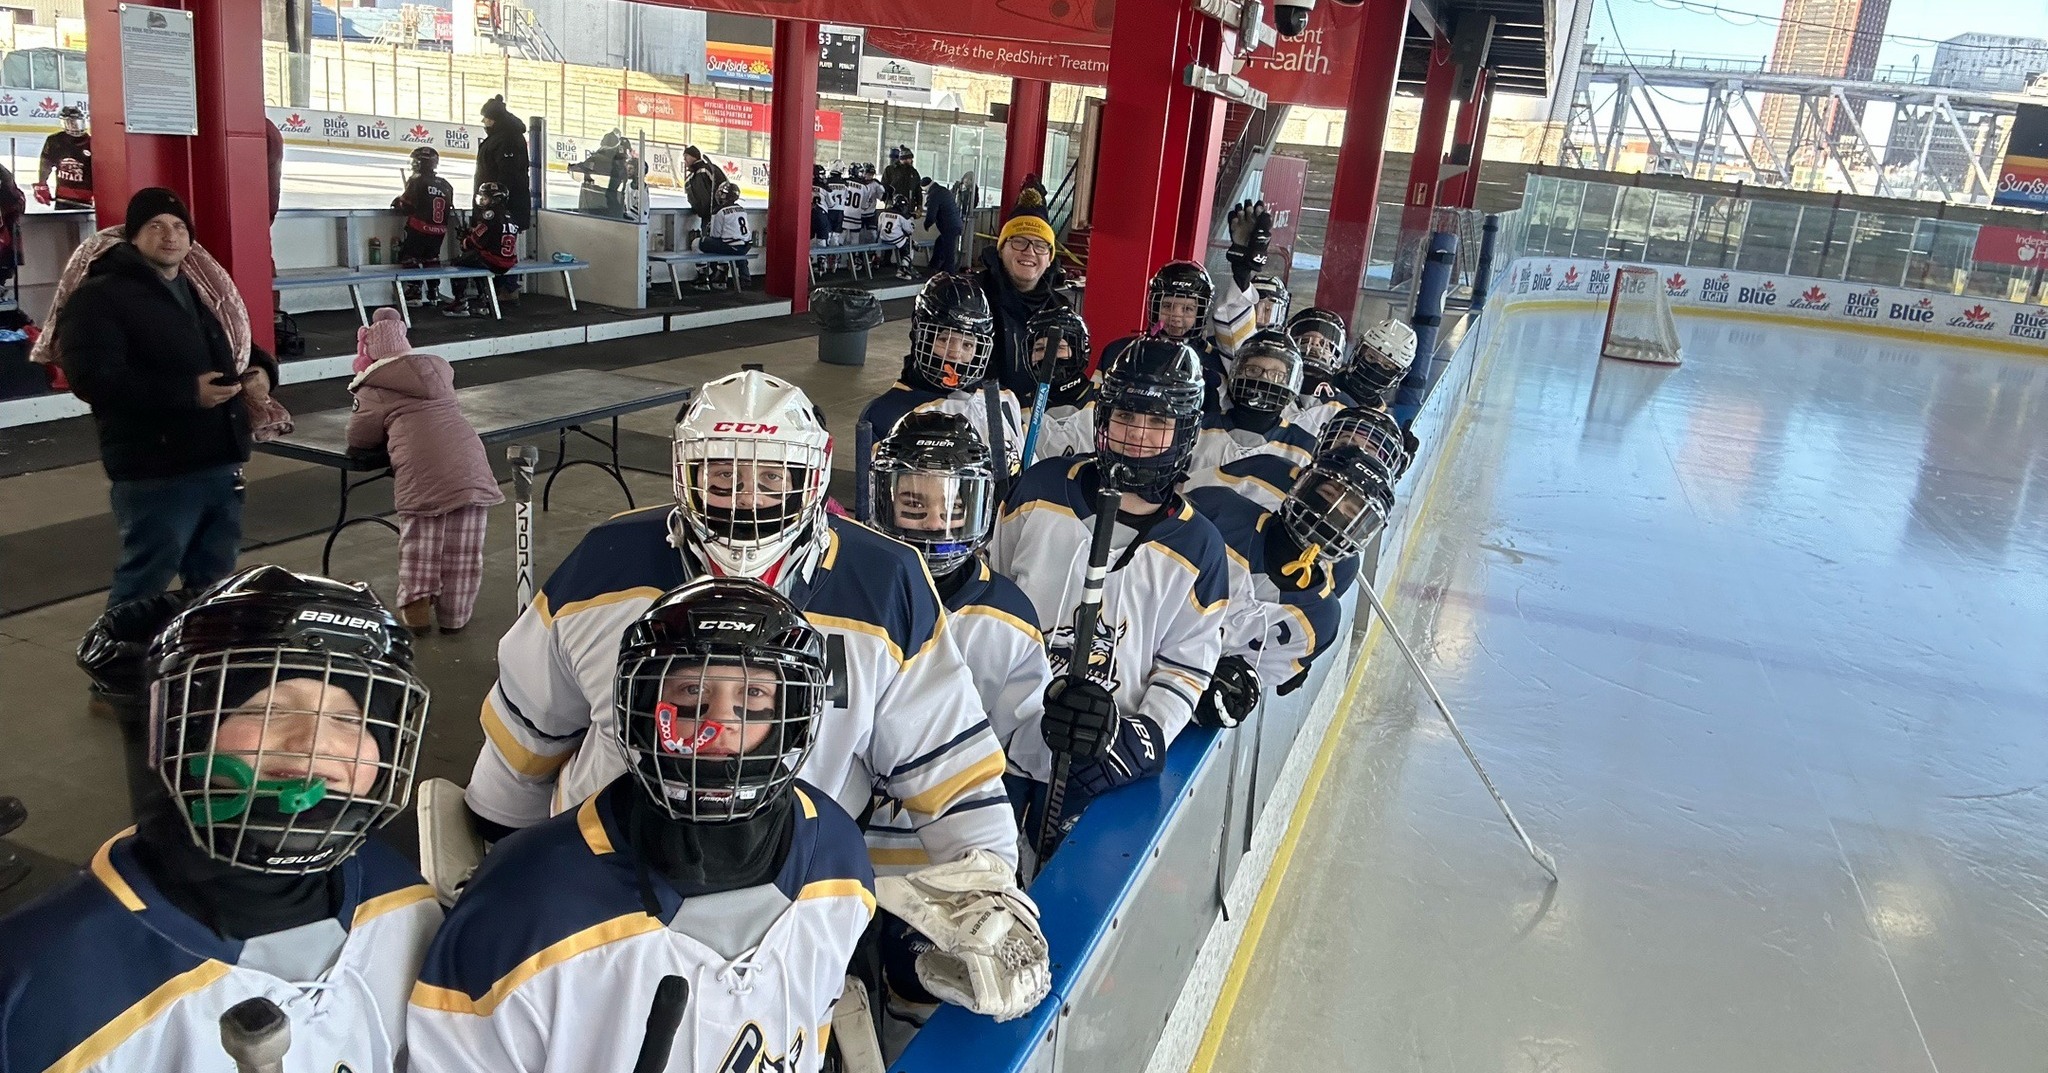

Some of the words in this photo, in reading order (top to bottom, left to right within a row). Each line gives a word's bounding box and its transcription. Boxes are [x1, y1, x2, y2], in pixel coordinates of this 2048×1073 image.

[822, 48, 828, 59] 2
[932, 39, 969, 57] That's
[973, 46, 994, 60] the
[707, 55, 748, 73] Surfside
[0, 104, 19, 117] ue
[29, 108, 60, 119] Laba
[648, 103, 674, 115] Health
[278, 123, 312, 134] Labatt
[323, 118, 349, 129] Blue
[324, 128, 349, 138] LIGHT
[357, 125, 390, 140] Blue
[400, 134, 434, 144] Labatt
[445, 129, 469, 140] Blue
[445, 139, 470, 149] LIGHT
[556, 141, 577, 152] Blue
[58, 170, 83, 182] ATTACK
[844, 190, 861, 209] 30
[432, 196, 445, 224] 8
[738, 216, 748, 236] 8
[1532, 274, 1551, 291] Blue
[1590, 269, 1611, 283] Blue
[1587, 283, 1609, 295] LIGHT
[1703, 278, 1730, 292] Blue
[1701, 290, 1729, 303] LIGHT
[1738, 287, 1777, 306] Blue
[1847, 293, 1880, 307] Blue
[1787, 298, 1821, 311] Labatt
[1845, 305, 1878, 319] LIGHT
[1889, 303, 1934, 323] Blue
[1946, 316, 1996, 331] Labatt
[2014, 313, 2048, 328] Blue
[2010, 325, 2047, 340] LIGHT
[1060, 378, 1081, 392] CCM
[1126, 387, 1162, 398] BAUER
[712, 422, 778, 435] CCM
[1355, 462, 1383, 484] CCM
[516, 502, 530, 572] APOR
[298, 610, 381, 632] BAUER
[698, 620, 756, 632] CCM
[266, 847, 333, 865] BAUER
[969, 910, 992, 936] BAUER
